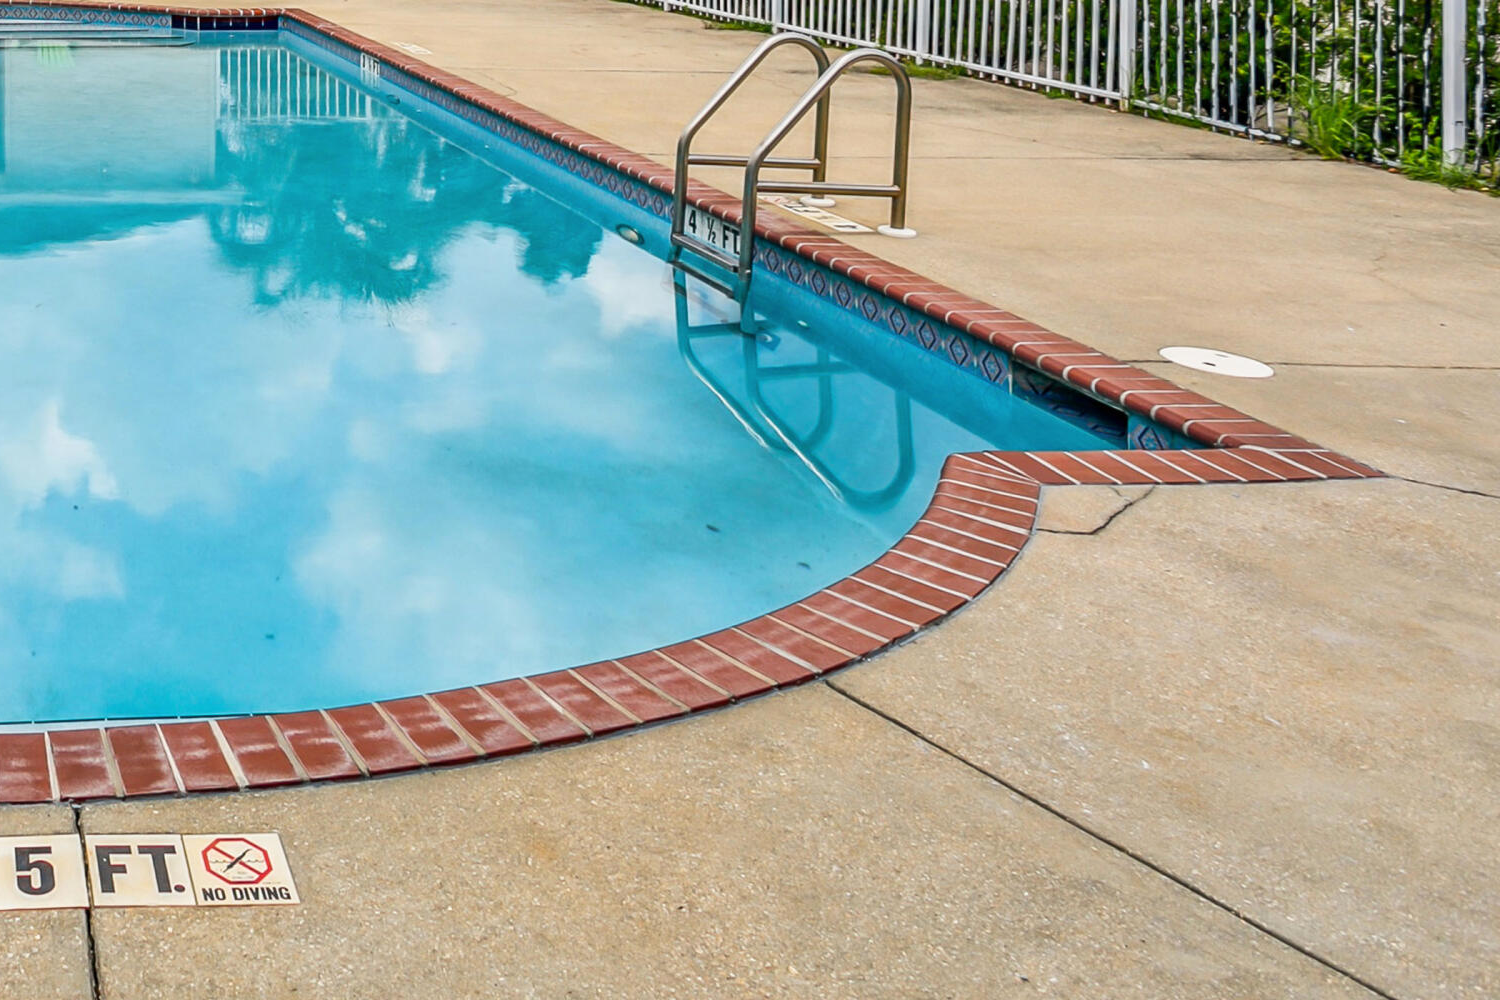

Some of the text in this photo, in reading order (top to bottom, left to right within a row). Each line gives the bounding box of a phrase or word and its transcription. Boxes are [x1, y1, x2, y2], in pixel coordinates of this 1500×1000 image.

[689, 209, 697, 234] 4
[14, 844, 186, 896] 5 FT.
[201, 886, 292, 902] NO DIVING
